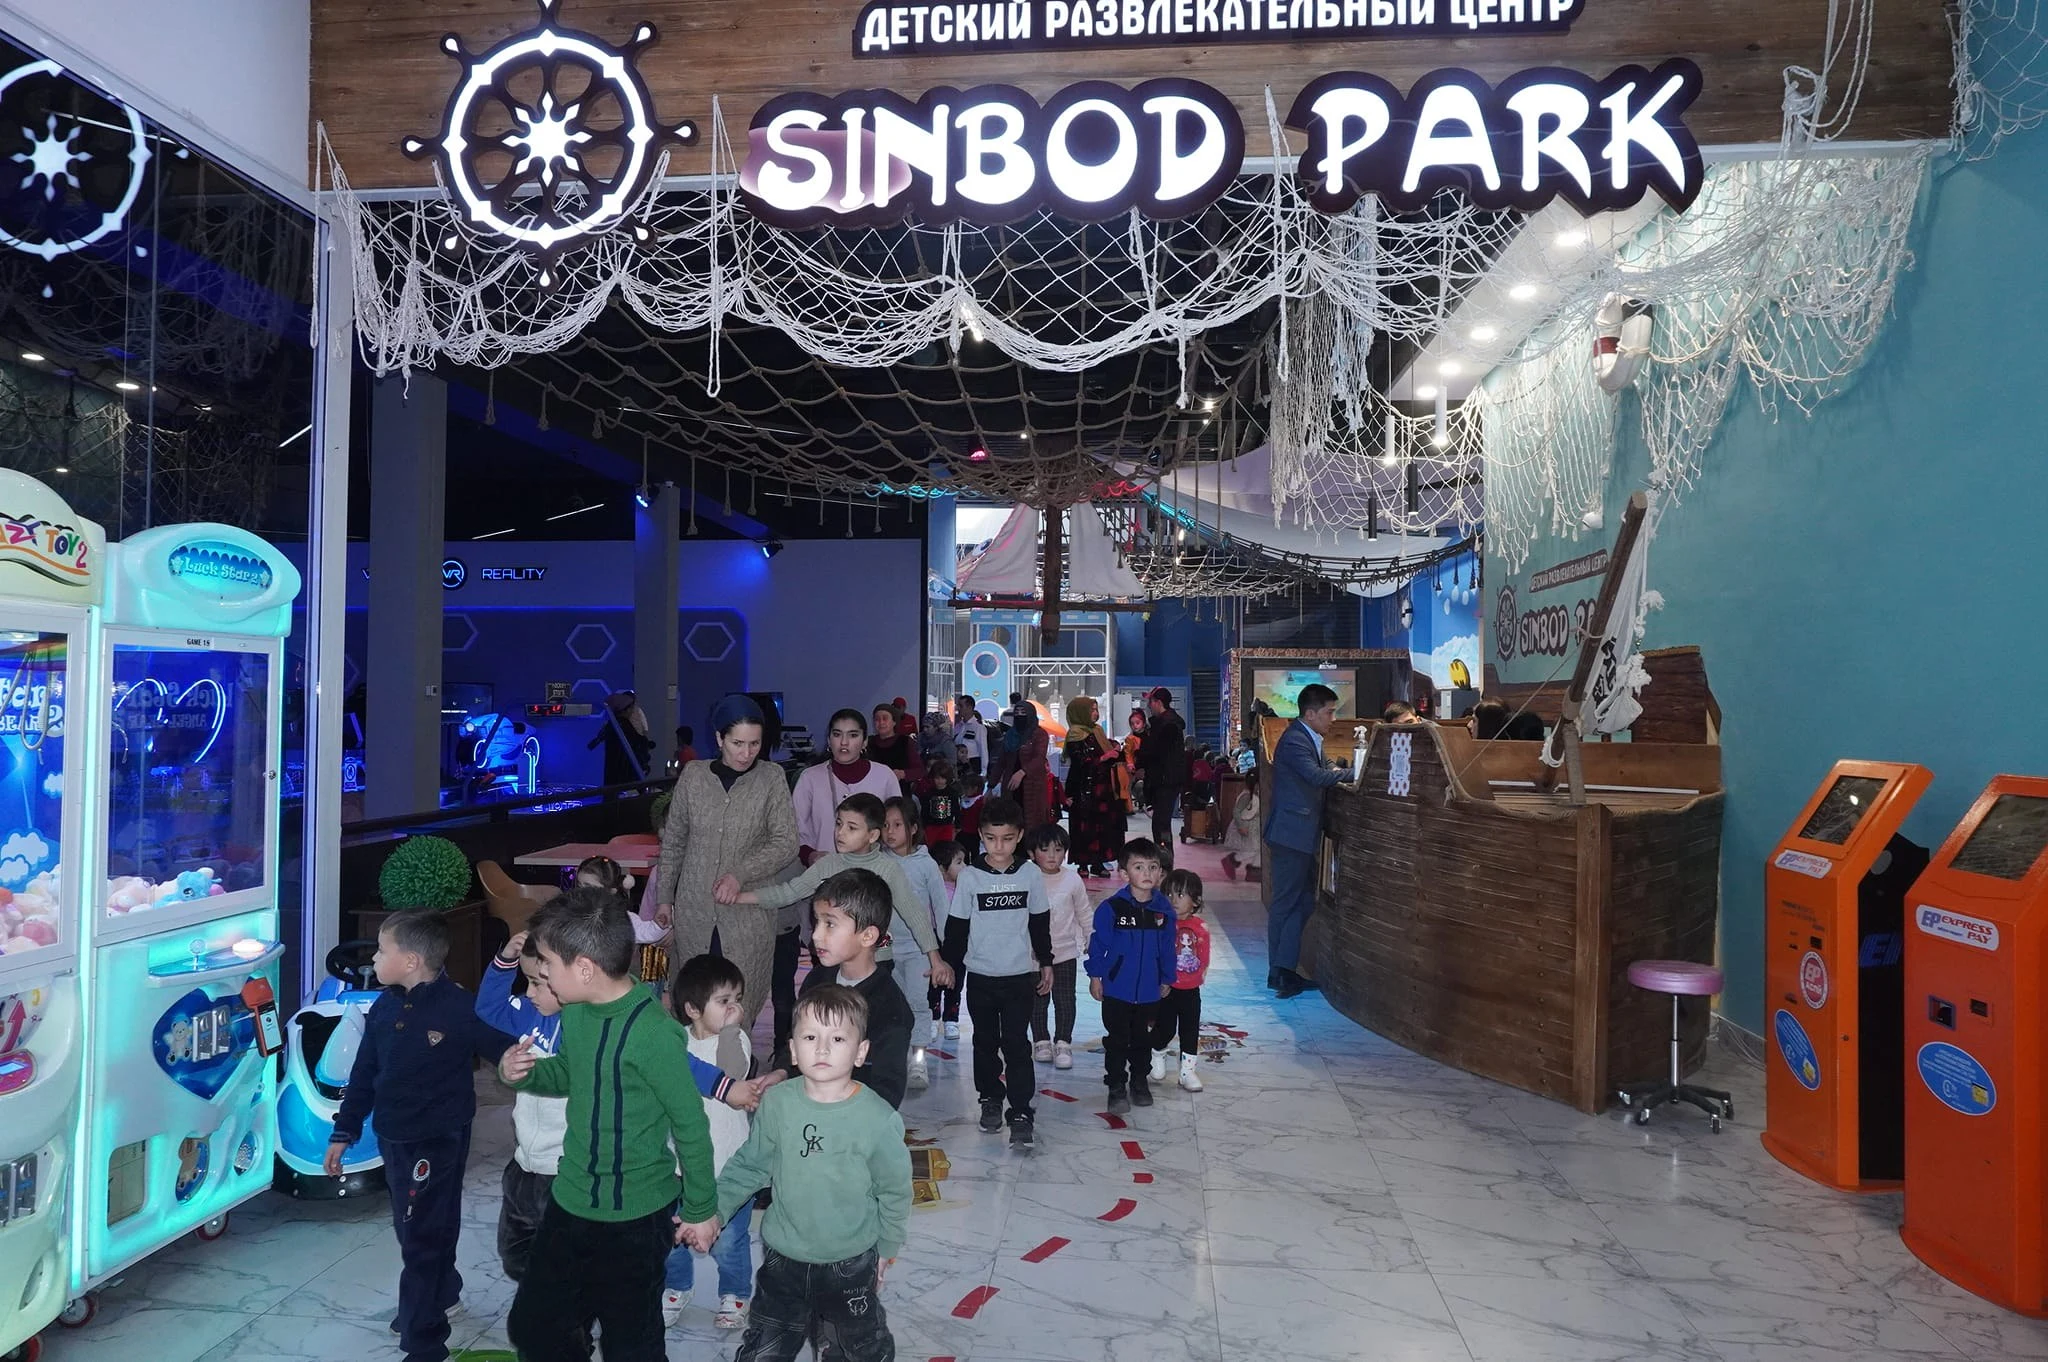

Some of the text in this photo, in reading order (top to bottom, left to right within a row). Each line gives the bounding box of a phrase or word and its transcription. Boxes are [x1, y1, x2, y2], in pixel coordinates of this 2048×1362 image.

[861, 0, 1575, 52] ДЕТСКИЙ РАЗВЛЕКАТЕЛЬНЫЙ ЦЕНТР
[757, 74, 1687, 211] SINBOD PARK
[45, 529, 80, 556] TOY
[75, 541, 88, 568] 2
[184, 556, 219, 576] Luck
[221, 563, 250, 581] Star
[482, 568, 545, 580] REALITY
[1521, 609, 1569, 653] SINBOD
[990, 883, 1017, 893] JUST
[985, 894, 1023, 907] STORK
[1921, 910, 1942, 928] EP
[1941, 915, 1993, 936] EXPRESS
[1967, 931, 1991, 945] PAY
